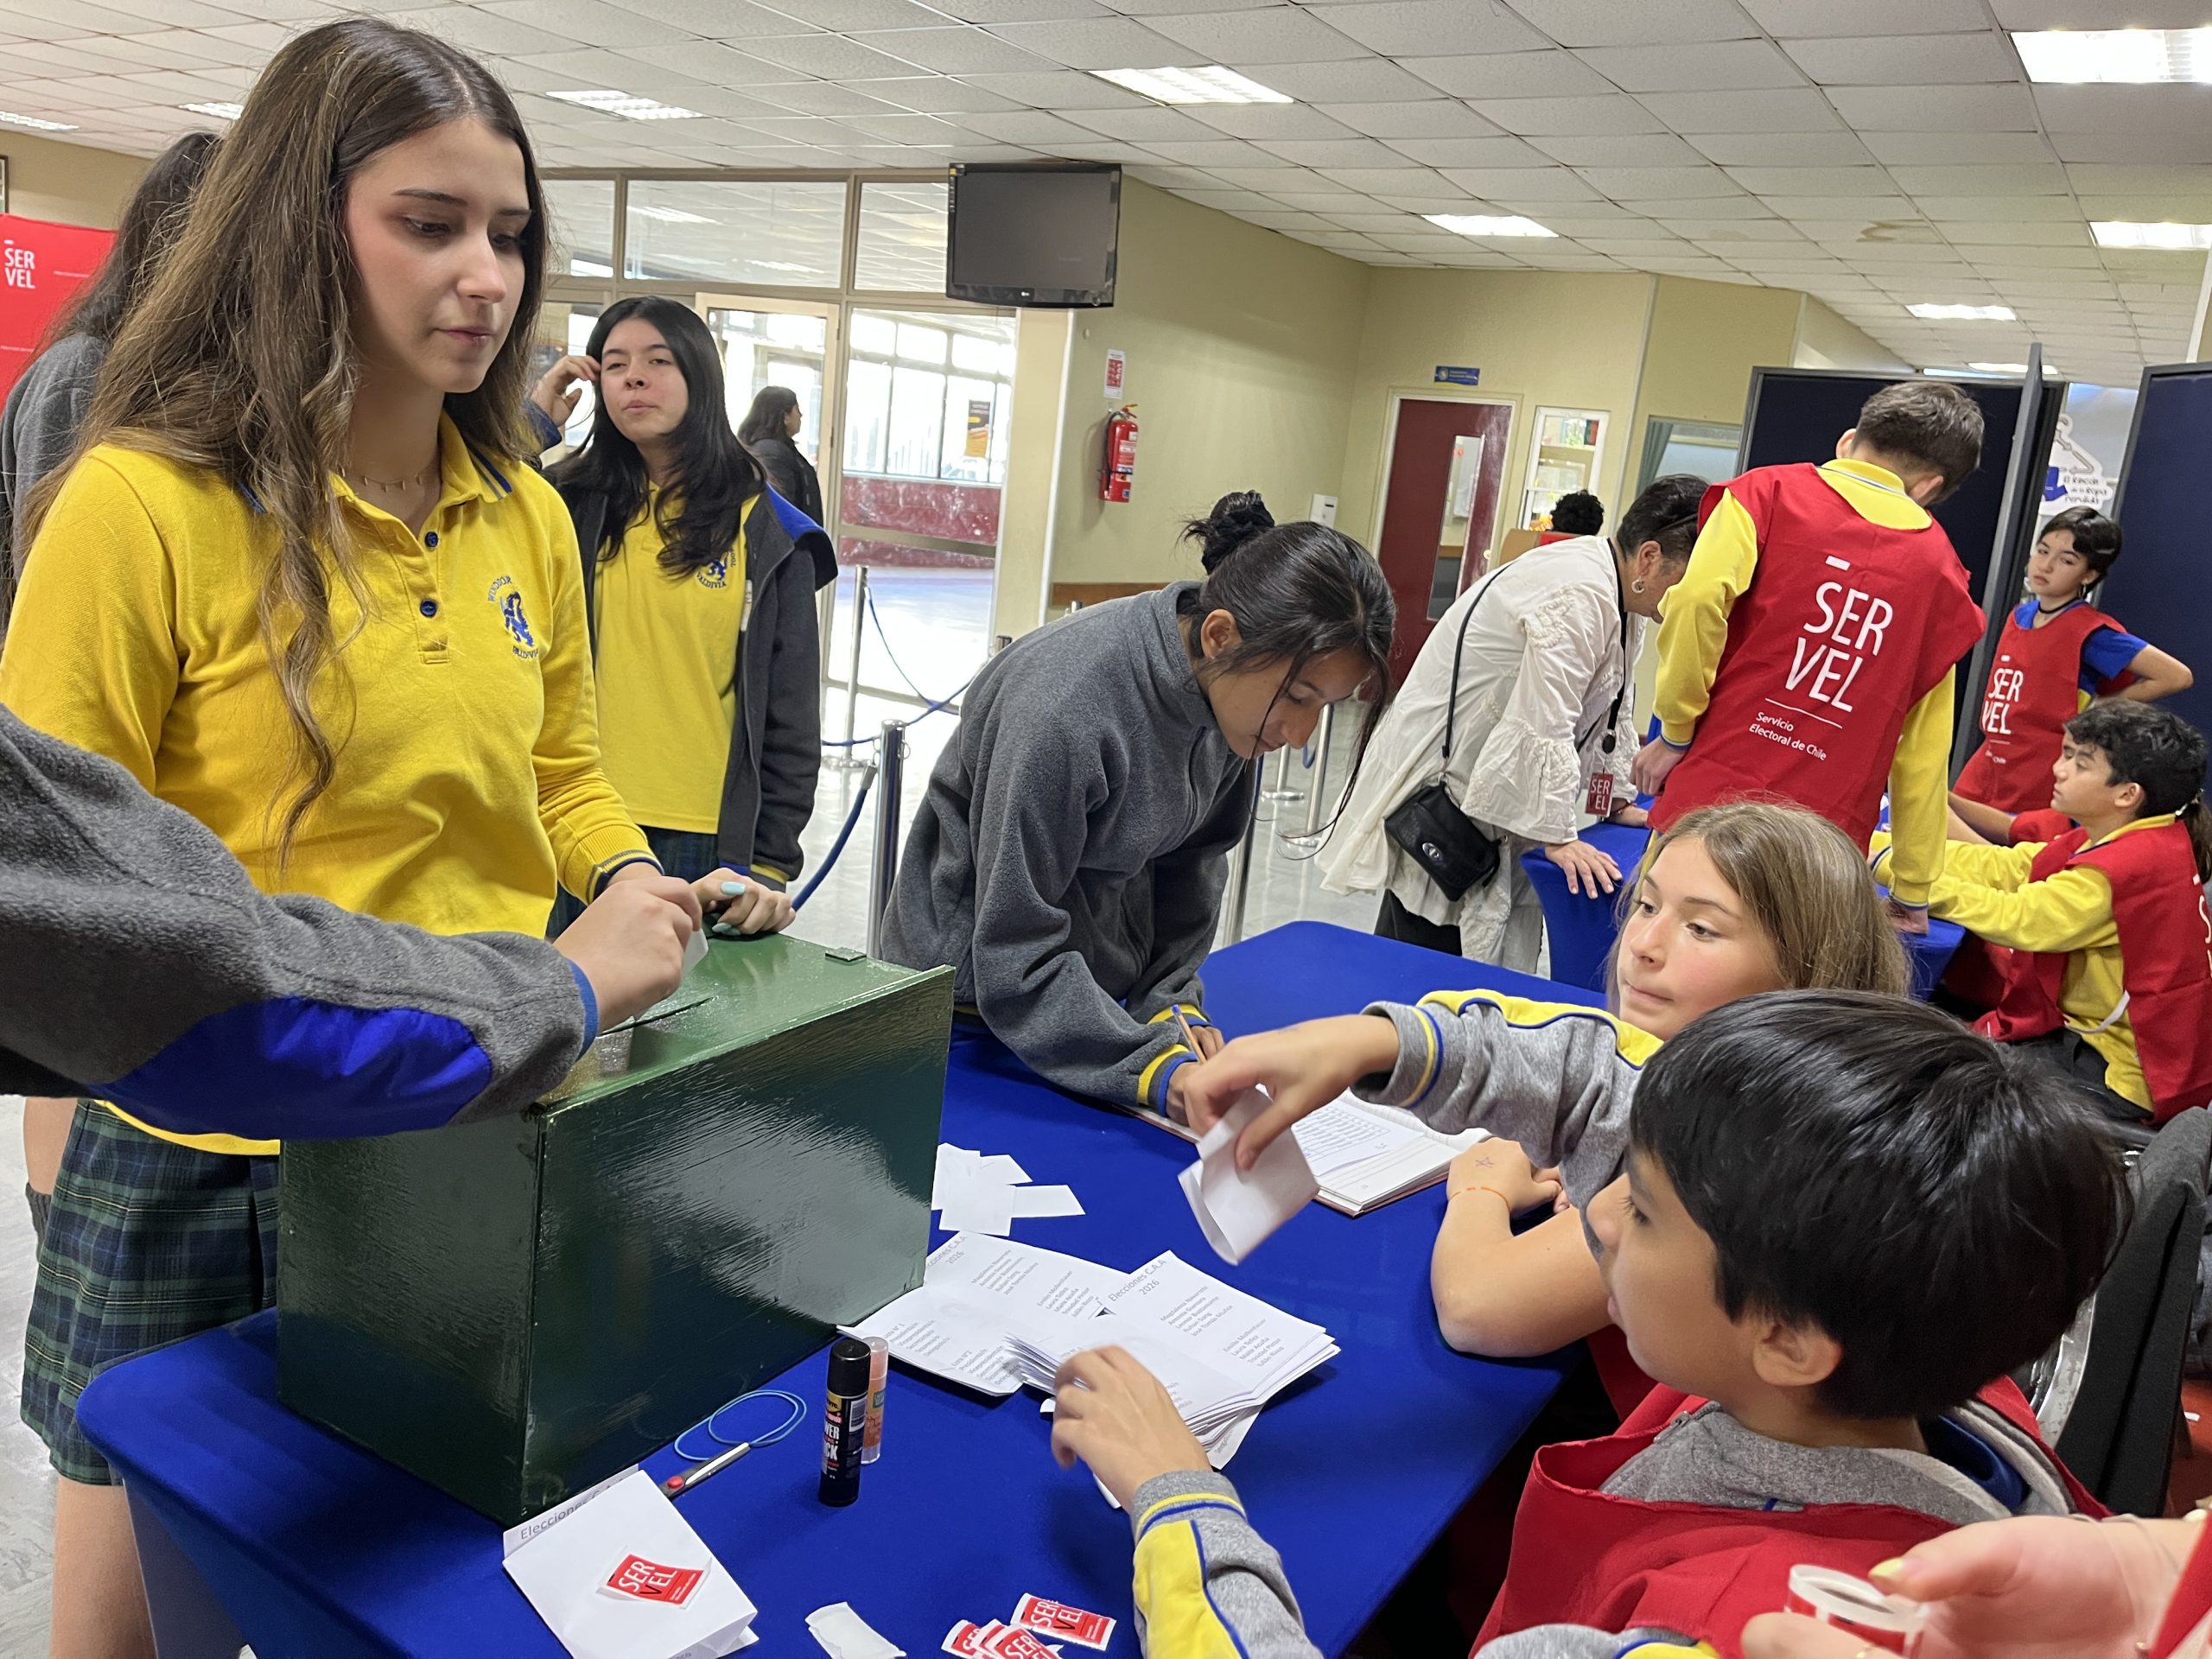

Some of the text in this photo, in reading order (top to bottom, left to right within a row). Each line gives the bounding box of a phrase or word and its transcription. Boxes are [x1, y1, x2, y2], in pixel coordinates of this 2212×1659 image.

[4, 248, 35, 270] SER
[4, 267, 35, 289] VEL
[1803, 582, 1893, 656] SER
[1785, 637, 1863, 712] VEL
[1988, 668, 2024, 702] SER
[1756, 712, 1794, 732] Servicio
[1981, 701, 2012, 734] VEL
[1749, 723, 1827, 760] Electoral de Chile
[1590, 779, 1611, 794] SER
[1108, 1274, 1147, 1301] Elecciones
[1139, 1279, 1160, 1295] 2026
[619, 1560, 655, 1592] SER
[639, 1570, 677, 1594] VEL
[1031, 1601, 1059, 1627] SER
[1053, 1609, 1083, 1630] VEL
[1004, 1635, 1042, 1659] SER
